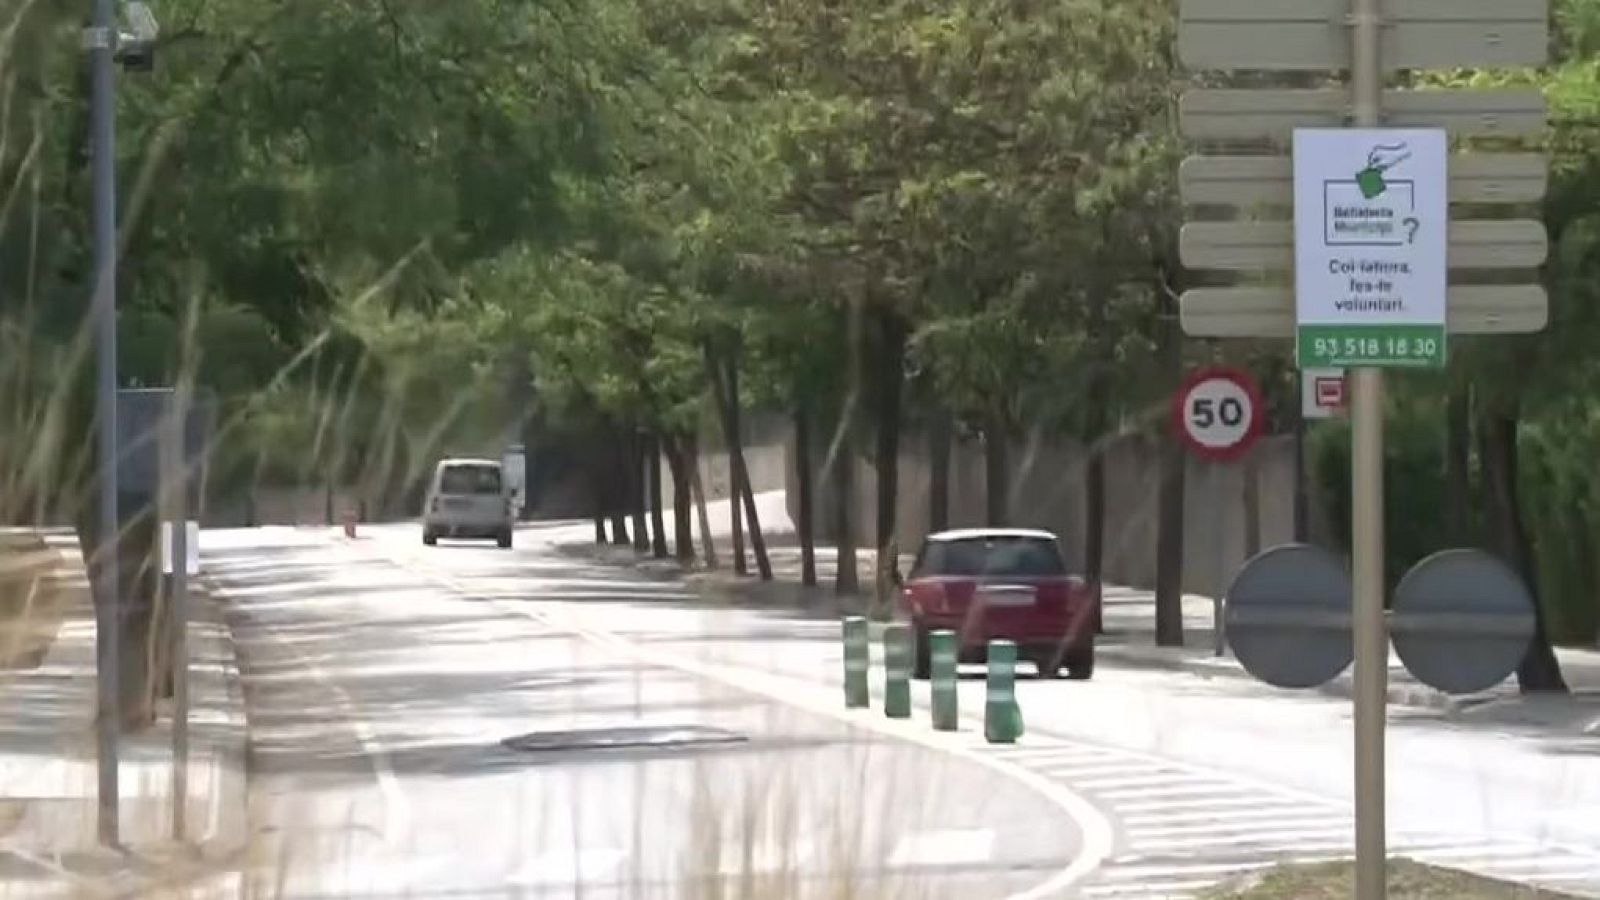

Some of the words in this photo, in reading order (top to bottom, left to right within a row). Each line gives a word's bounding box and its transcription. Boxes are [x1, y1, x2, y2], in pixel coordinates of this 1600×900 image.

[1314, 338, 1337, 356] 93
[1344, 338, 1379, 356] 518
[1414, 338, 1436, 356] 30
[1192, 397, 1242, 428] 50
